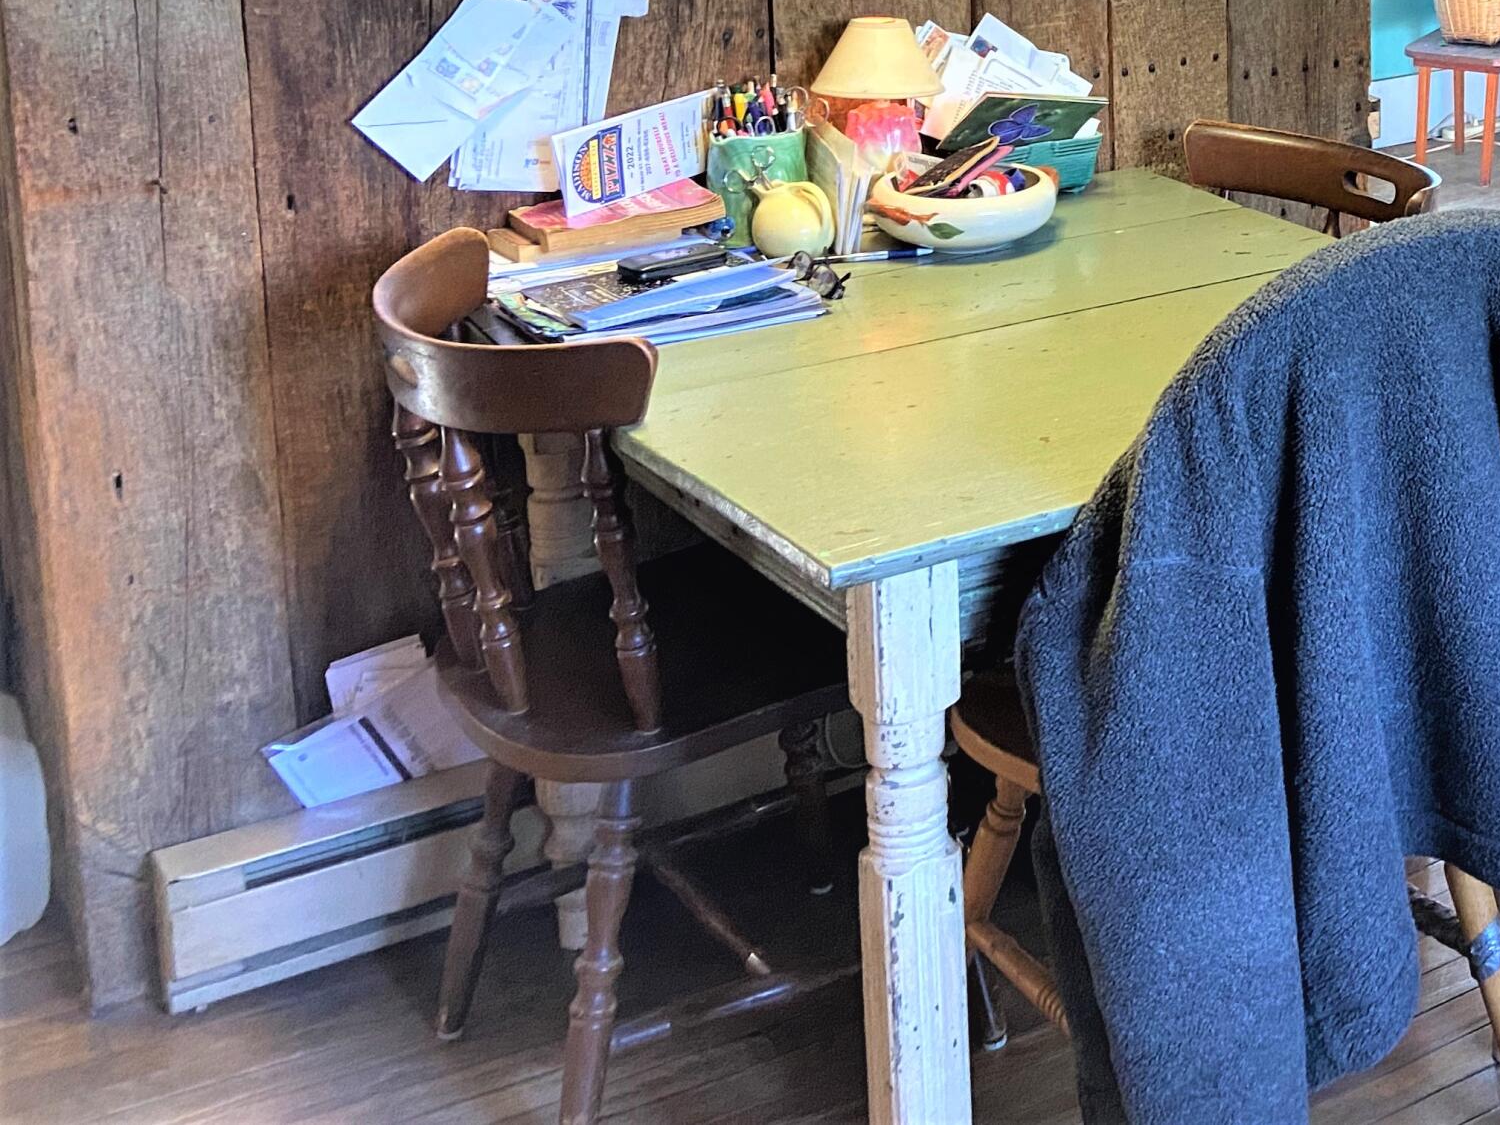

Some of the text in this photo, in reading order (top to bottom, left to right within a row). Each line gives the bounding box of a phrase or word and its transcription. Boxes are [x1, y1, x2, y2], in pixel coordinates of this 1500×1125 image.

[626, 145, 635, 170] 2022
[653, 126, 664, 155] YOURSELF
[572, 144, 592, 201] MADISON
[603, 134, 619, 195] PIZZA
